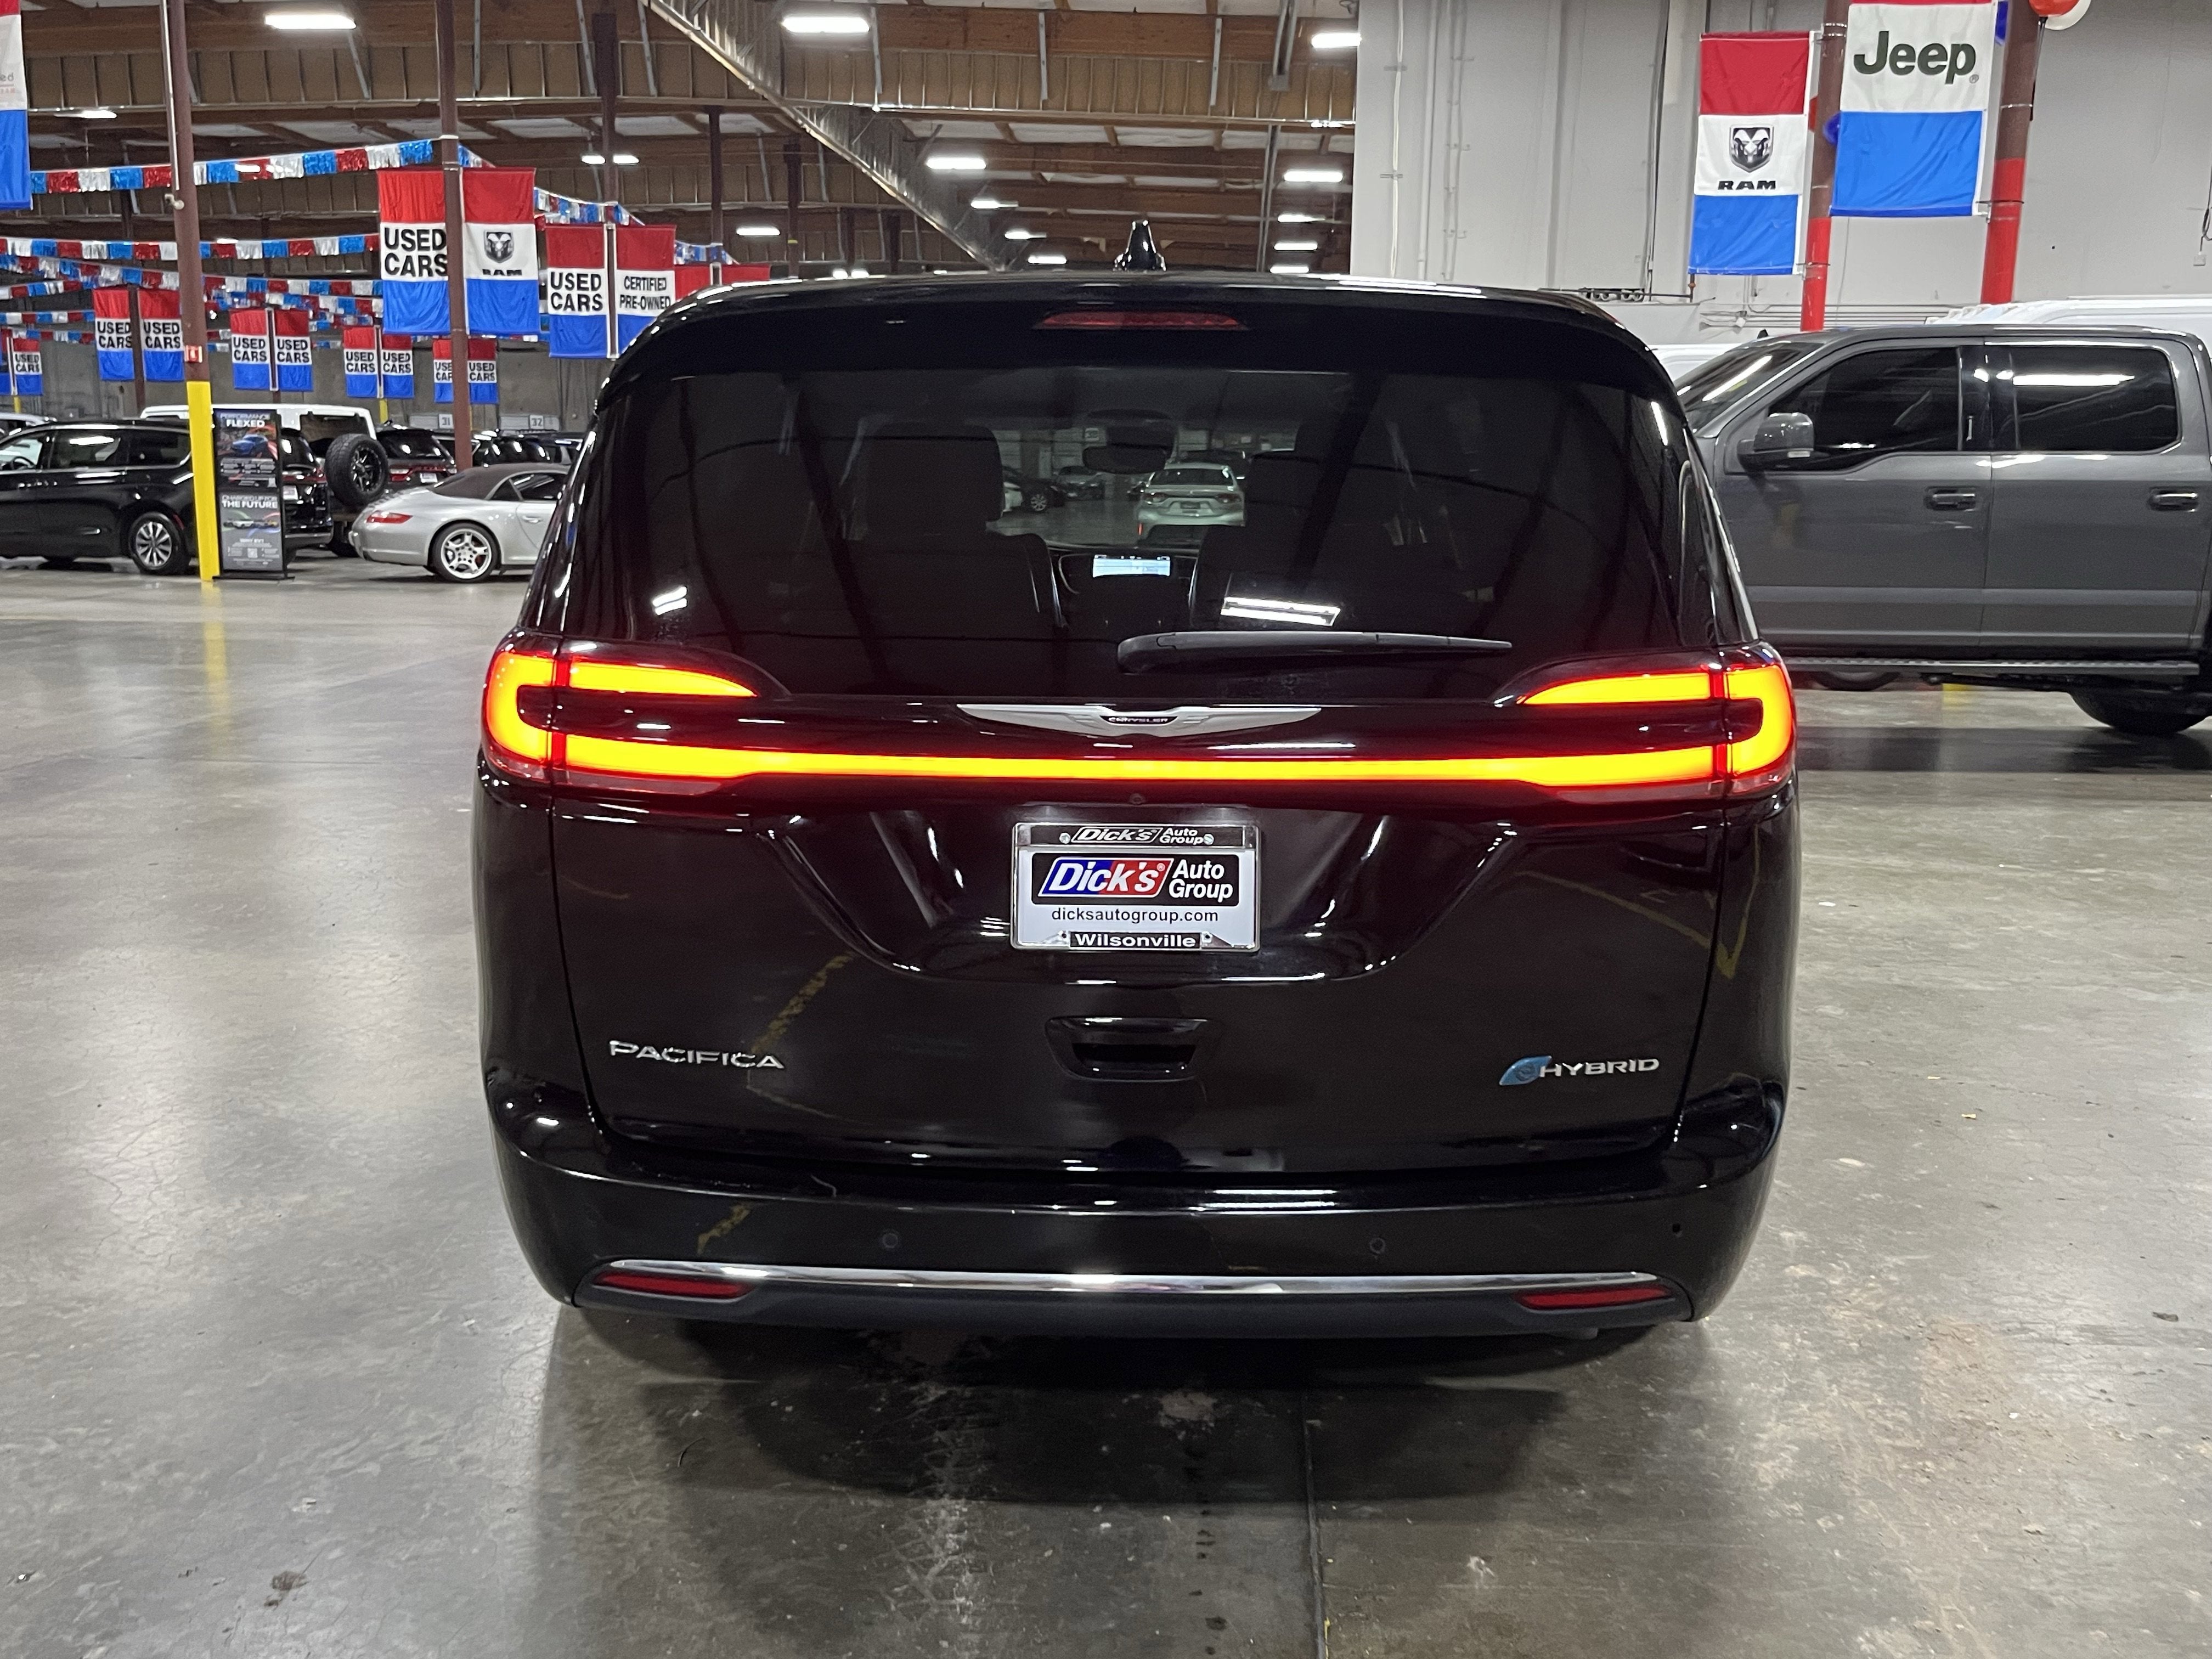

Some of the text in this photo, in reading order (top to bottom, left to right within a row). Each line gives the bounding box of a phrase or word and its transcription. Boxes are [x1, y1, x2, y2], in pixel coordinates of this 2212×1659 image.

[1854, 31, 1976, 84] Jeep
[1718, 180, 1776, 190] RAM
[384, 227, 447, 251] USED
[384, 252, 448, 277] CARS
[550, 272, 602, 291] USED
[624, 276, 667, 291] CERTIFIED
[550, 292, 603, 312] CARS
[619, 294, 671, 310] PRE-OWNED
[97, 321, 131, 335] USED
[143, 321, 180, 335] USED
[98, 335, 132, 348] CARS
[145, 336, 181, 349] CARS
[233, 337, 266, 349] USED
[277, 338, 308, 351] USED
[15, 354, 40, 363] USED
[234, 349, 267, 362] CARS
[277, 351, 309, 363] CARS
[346, 351, 375, 362] USED
[383, 352, 411, 363] USED
[15, 363, 40, 373] CARS
[346, 363, 375, 373] CARS
[383, 363, 411, 374] CARS
[435, 362, 452, 371] USE
[469, 362, 495, 371] USED
[470, 372, 495, 381] CARS
[226, 419, 265, 427] FLEXED
[442, 417, 450, 426] 31
[531, 417, 542, 427] 32
[241, 500, 278, 509] FUTURE
[1077, 827, 1153, 841] Dick's
[1162, 827, 1198, 836] Auto
[1159, 834, 1204, 845] Group
[1172, 859, 1225, 879] Auto
[1048, 861, 1156, 892] Dick's
[1169, 878, 1233, 903] Group
[1052, 907, 1218, 924] dicksautogroup.com
[1074, 933, 1196, 947] Wilsonville
[610, 1040, 785, 1069] PACIFICA
[1540, 1058, 1660, 1077] HYBRID
